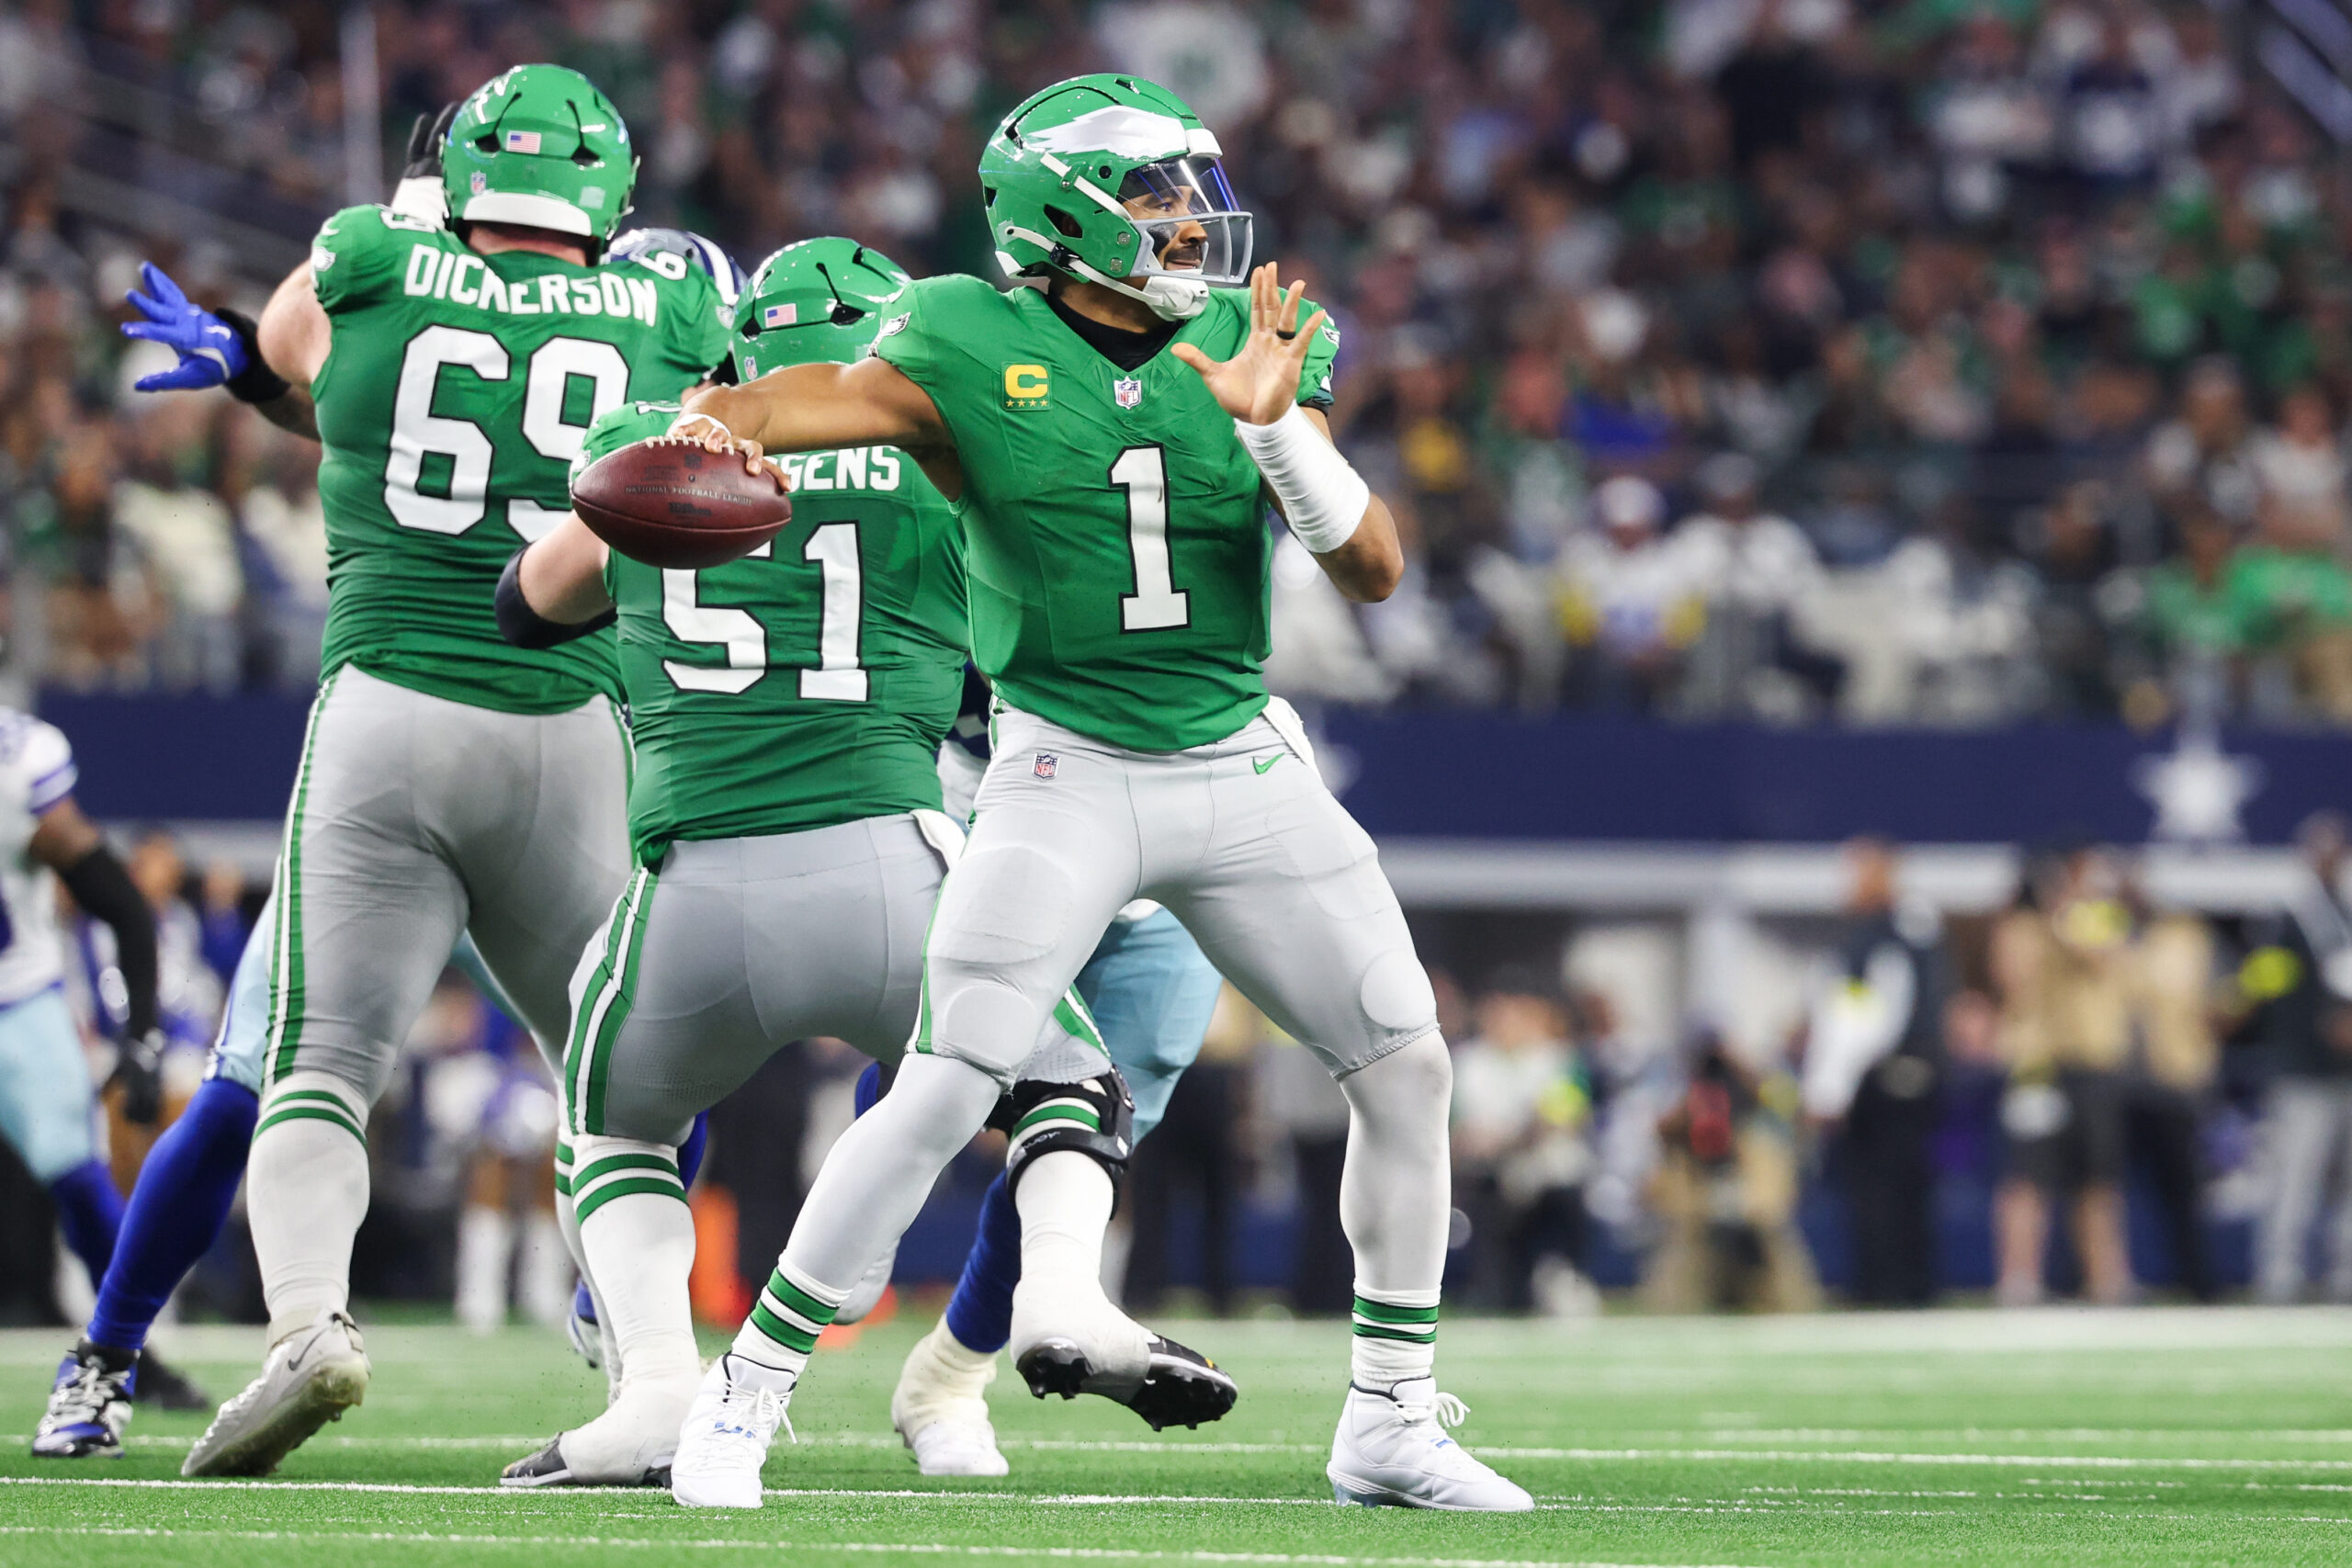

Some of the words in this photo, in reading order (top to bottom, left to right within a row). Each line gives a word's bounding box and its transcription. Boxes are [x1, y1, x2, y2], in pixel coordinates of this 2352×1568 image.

[403, 243, 658, 328] DICKERSON
[383, 322, 631, 545] 69
[1005, 364, 1048, 399] C
[626, 485, 669, 495] NATIONAL
[673, 486, 719, 501] FOOTBALL
[722, 492, 753, 507] LEAGUE
[1107, 443, 1192, 635] 1
[660, 520, 871, 702] 51
